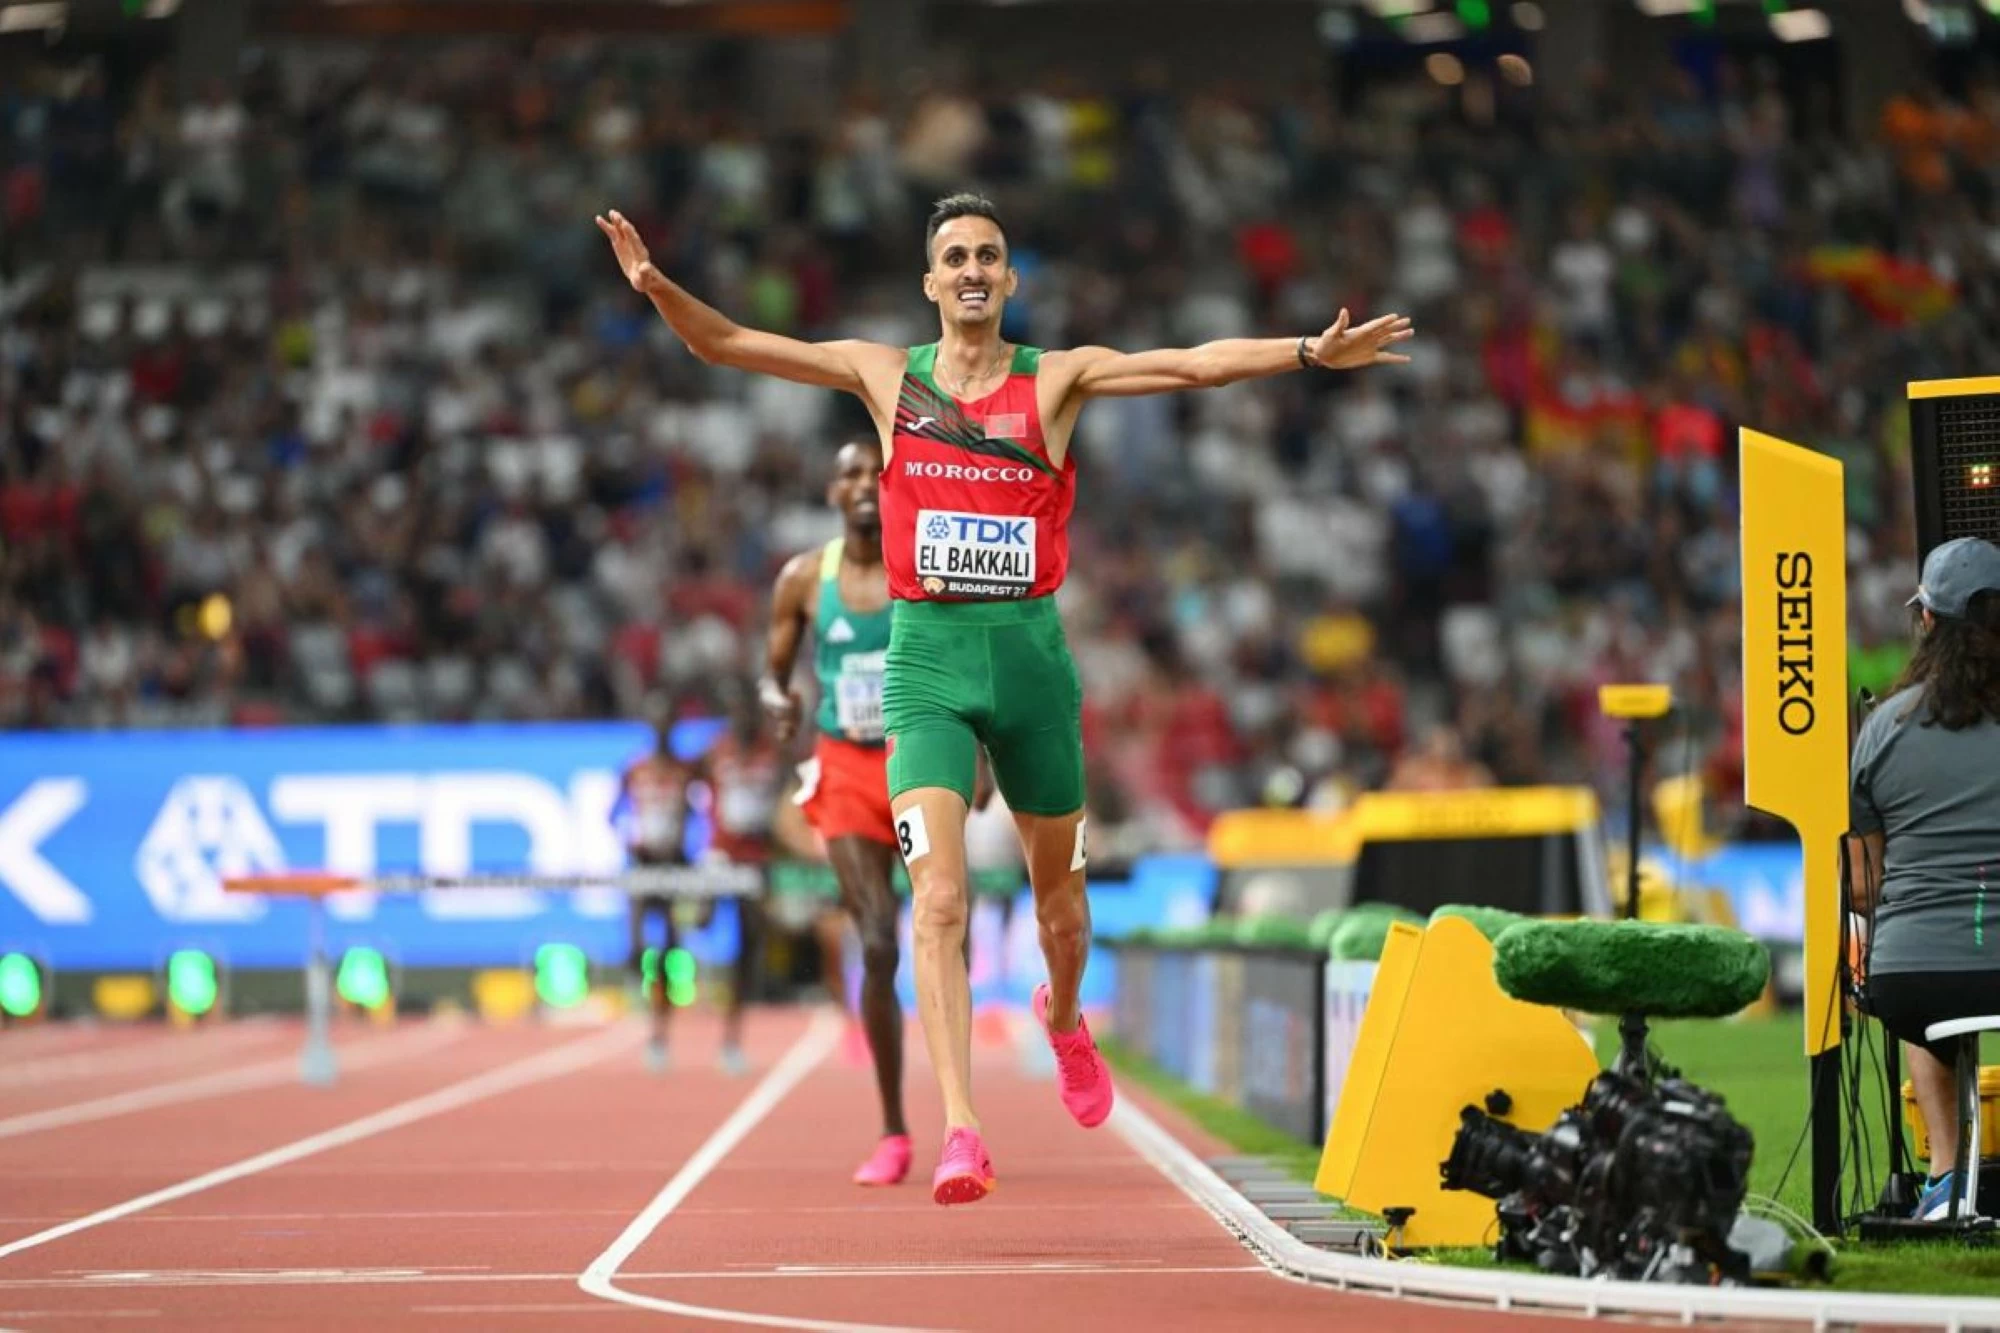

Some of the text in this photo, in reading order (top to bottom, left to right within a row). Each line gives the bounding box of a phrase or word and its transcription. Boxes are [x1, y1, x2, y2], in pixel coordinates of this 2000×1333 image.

[905, 461, 1034, 481] MOROCCO
[951, 516, 1028, 545] TDK
[920, 545, 1030, 577] EL BAKKALI
[948, 581, 1012, 595] BUDAPEST
[1776, 552, 1814, 735] SEIKO
[899, 820, 913, 857] 8
